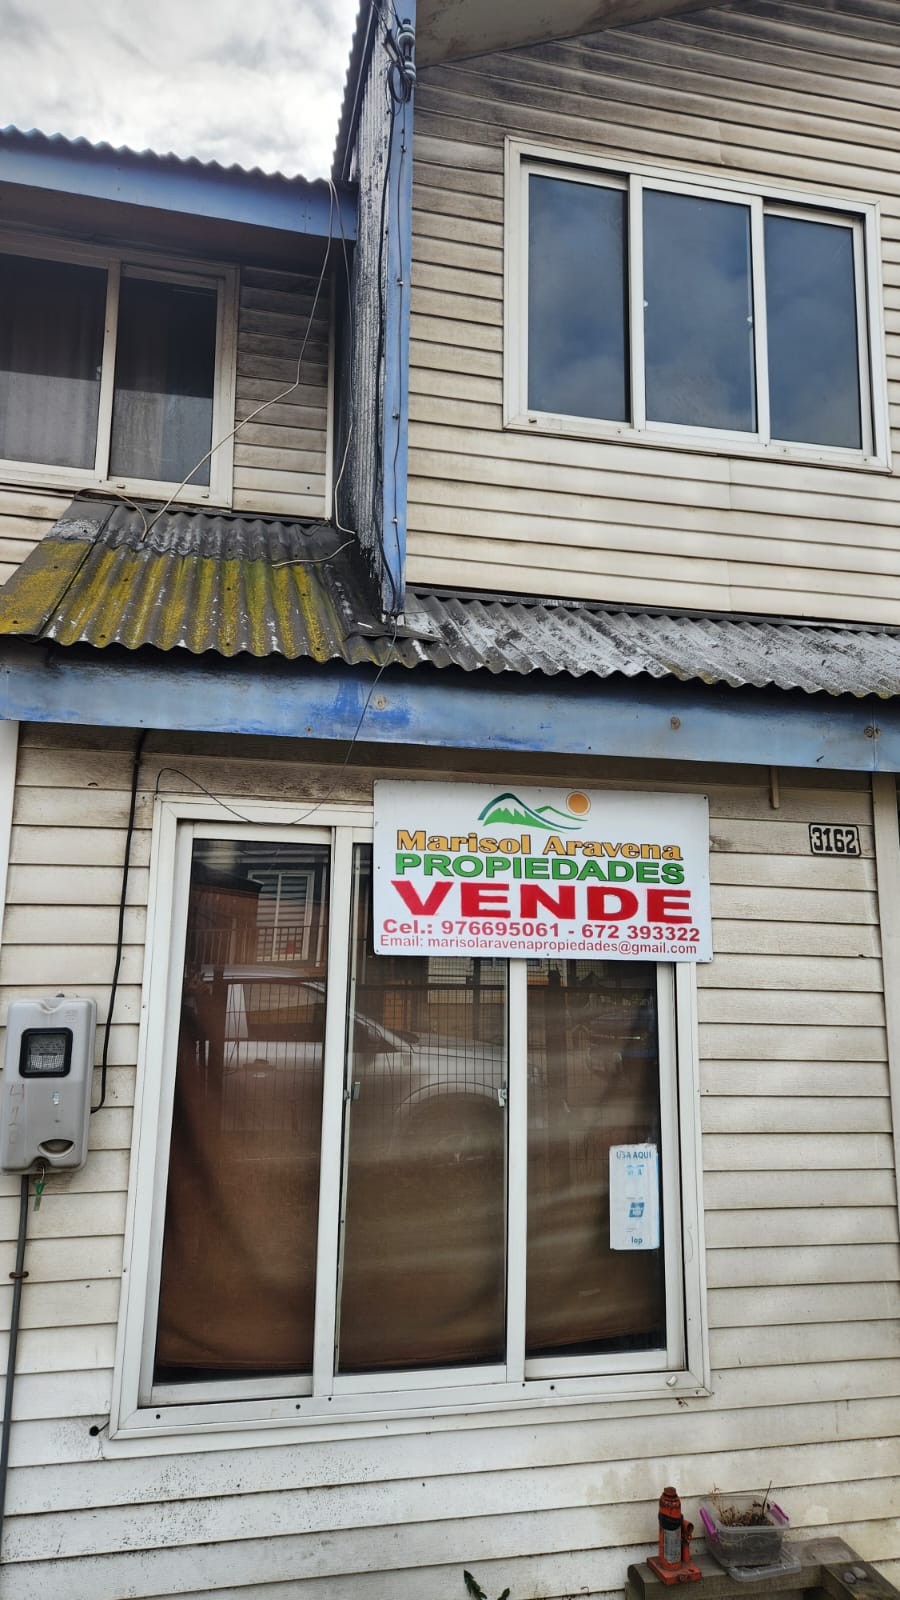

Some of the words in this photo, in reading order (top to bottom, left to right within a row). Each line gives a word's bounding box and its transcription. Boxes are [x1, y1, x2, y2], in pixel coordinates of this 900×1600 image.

[396, 829, 532, 855] Marisol
[542, 835, 684, 861] Aravena
[812, 827, 857, 853] 3162
[395, 852, 685, 885] PROPIEDADES
[390, 879, 693, 924] VENDE
[382, 918, 433, 935] Cel.:
[441, 919, 559, 937] 976695061
[581, 923, 620, 940] 672
[626, 924, 701, 942] 393322
[380, 934, 424, 947] Email:
[427, 935, 698, 956] marisolaravenapropiedades@gmail.com
